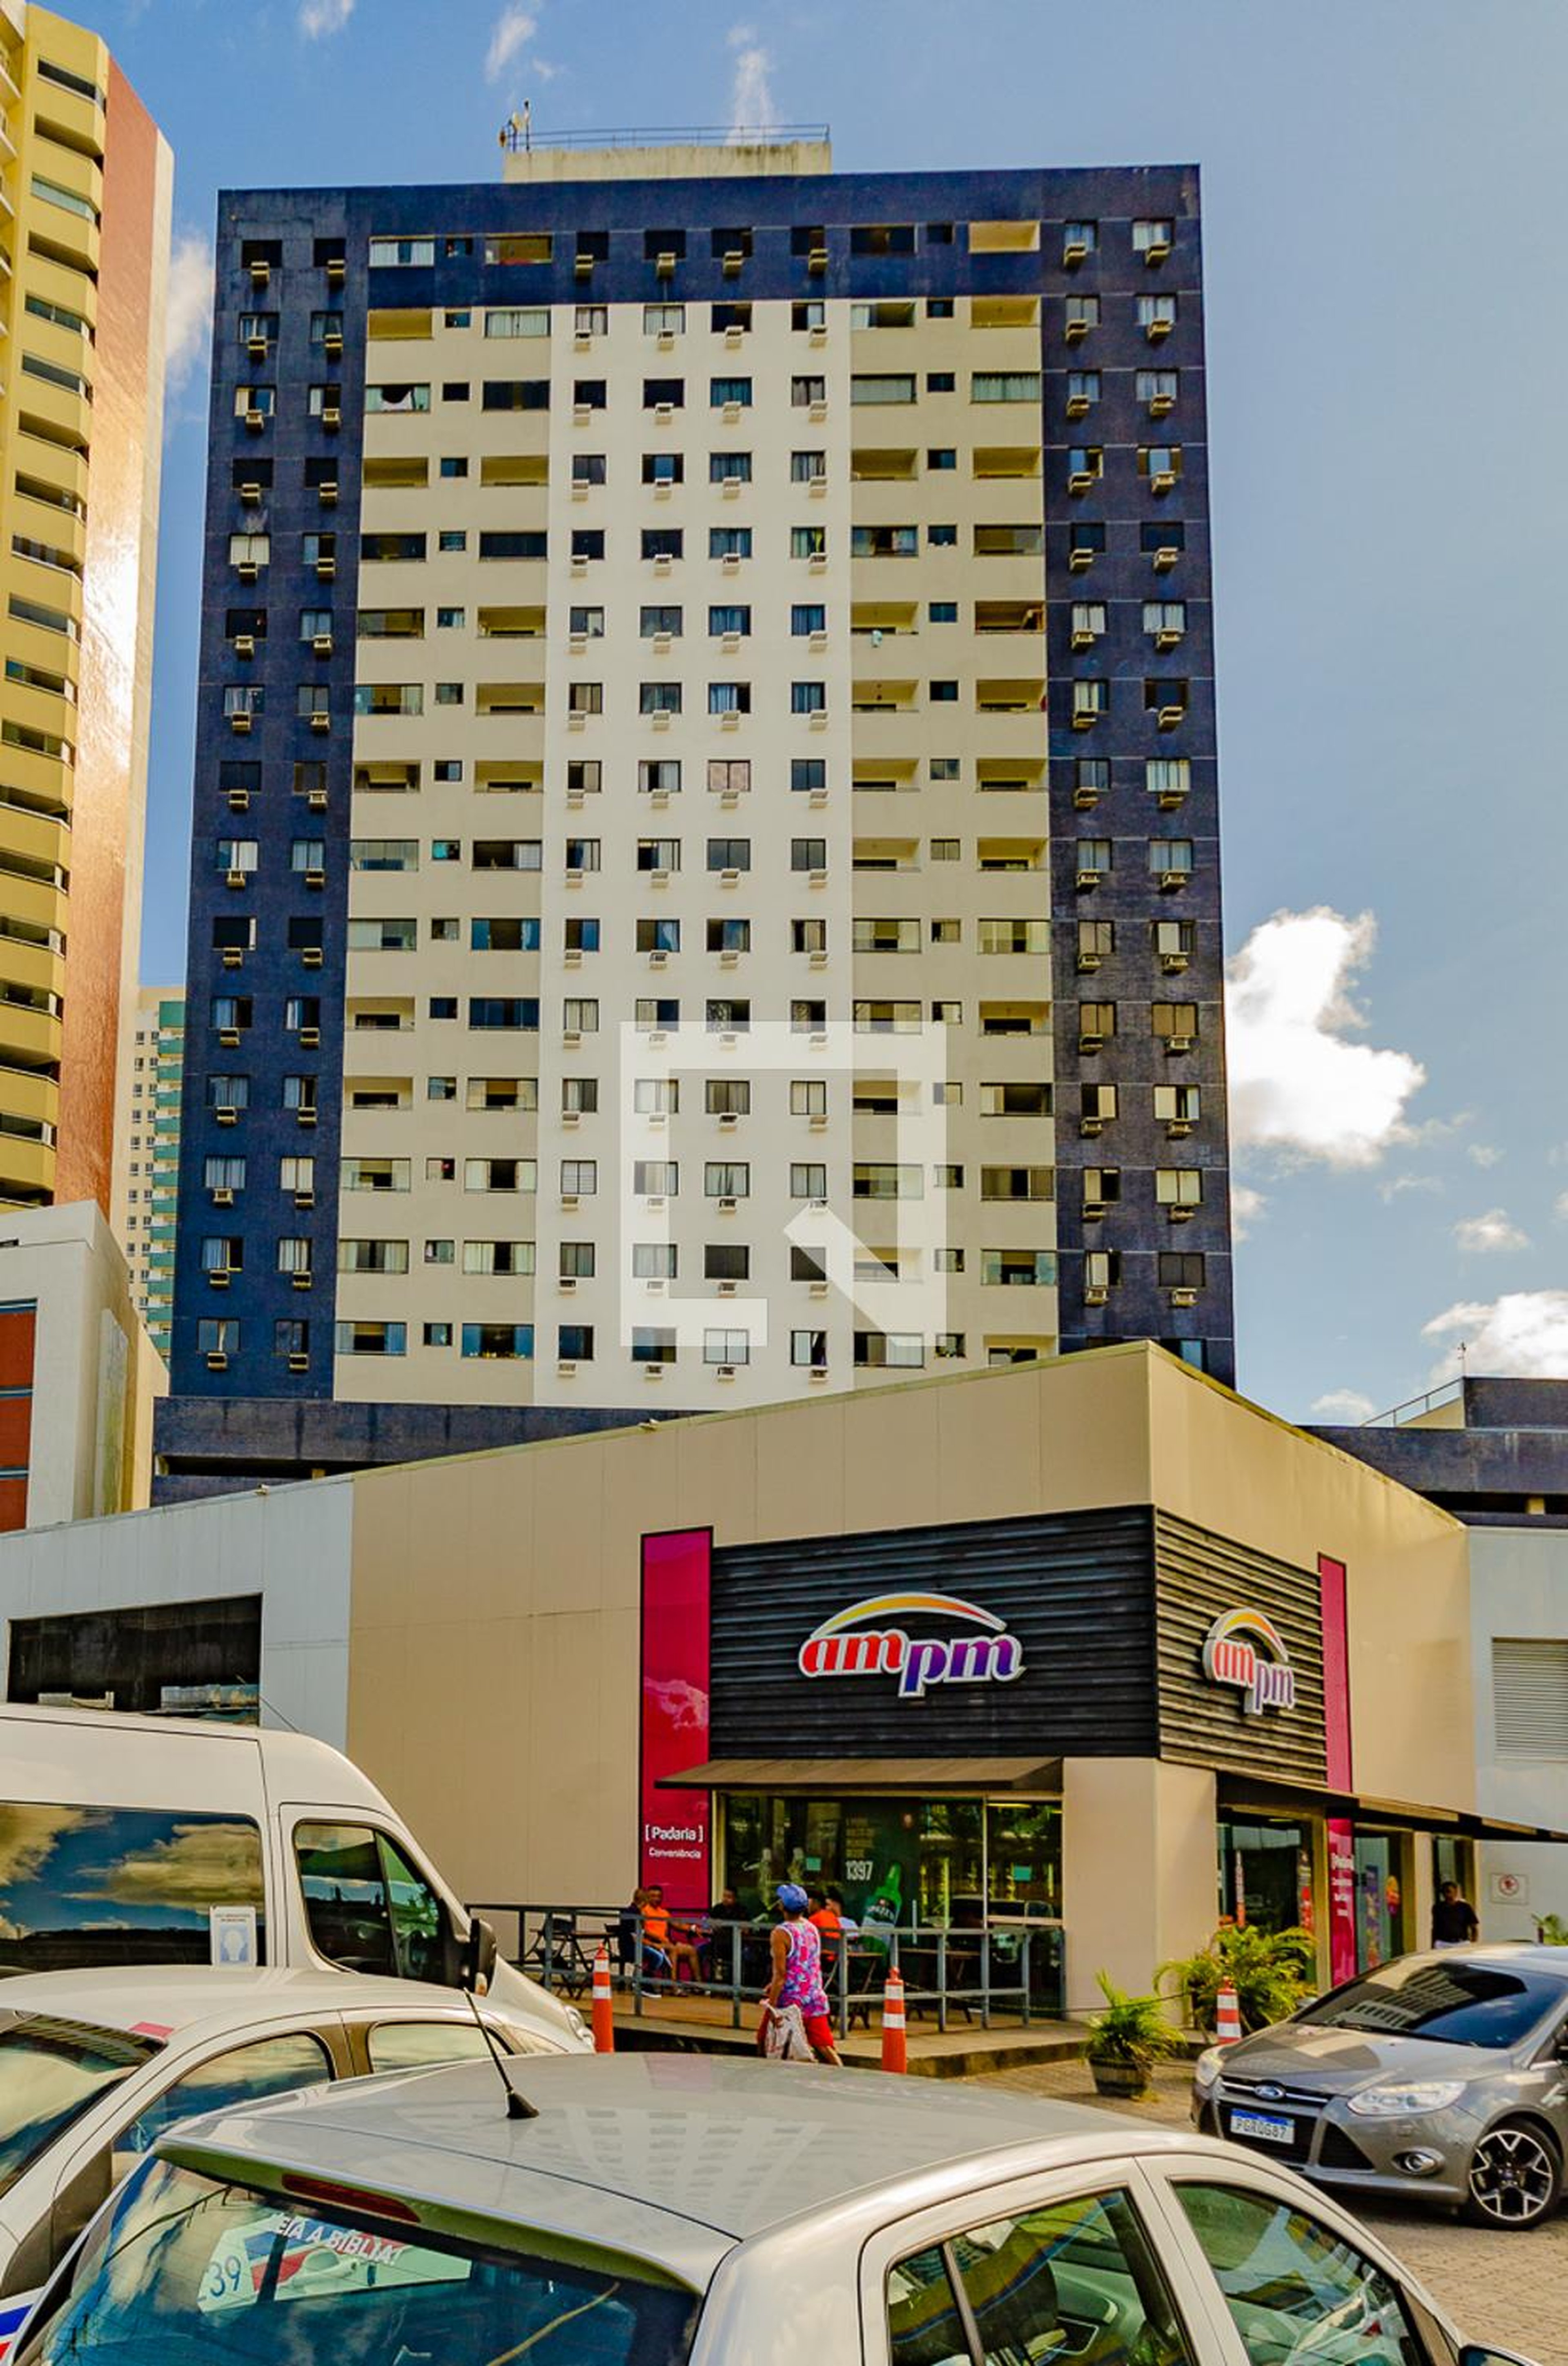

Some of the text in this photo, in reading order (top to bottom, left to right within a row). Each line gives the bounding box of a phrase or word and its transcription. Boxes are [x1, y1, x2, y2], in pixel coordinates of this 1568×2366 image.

[799, 1630, 1026, 1697] ampm
[1204, 1637, 1296, 1715] ampm
[845, 1860, 873, 1880] 1397
[307, 2226, 324, 2244] A
[208, 2254, 241, 2297] 39
